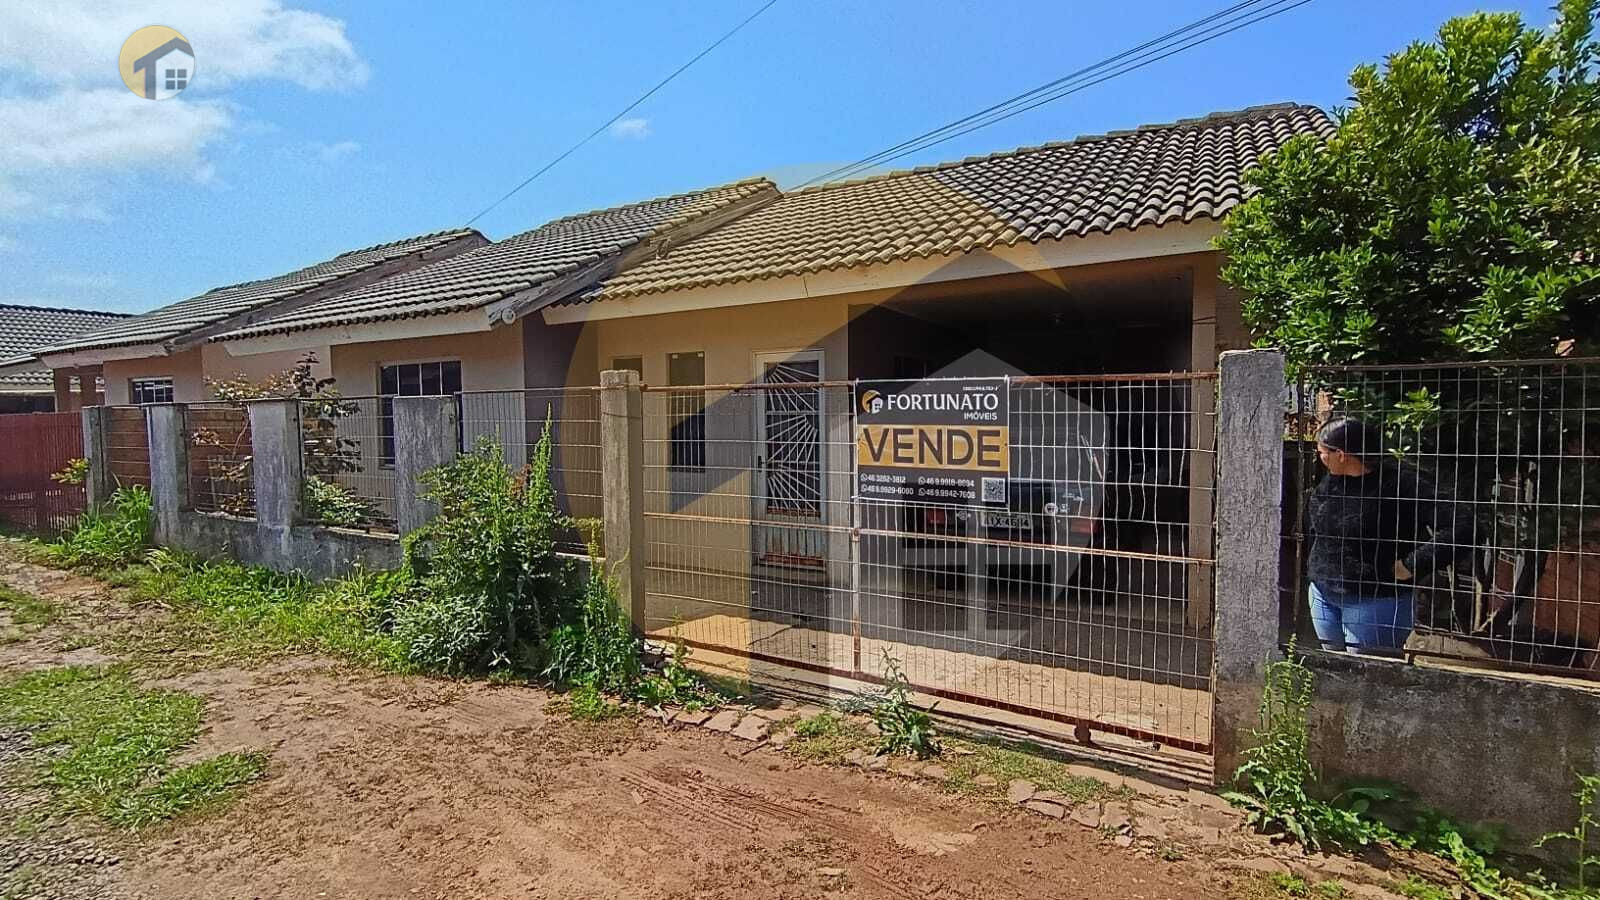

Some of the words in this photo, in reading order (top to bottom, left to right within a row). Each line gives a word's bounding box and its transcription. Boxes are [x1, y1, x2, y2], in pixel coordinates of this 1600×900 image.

[887, 393, 999, 411] FORTUNATO
[963, 411, 998, 421] IMÓVEIS
[863, 428, 1001, 467] VENDE
